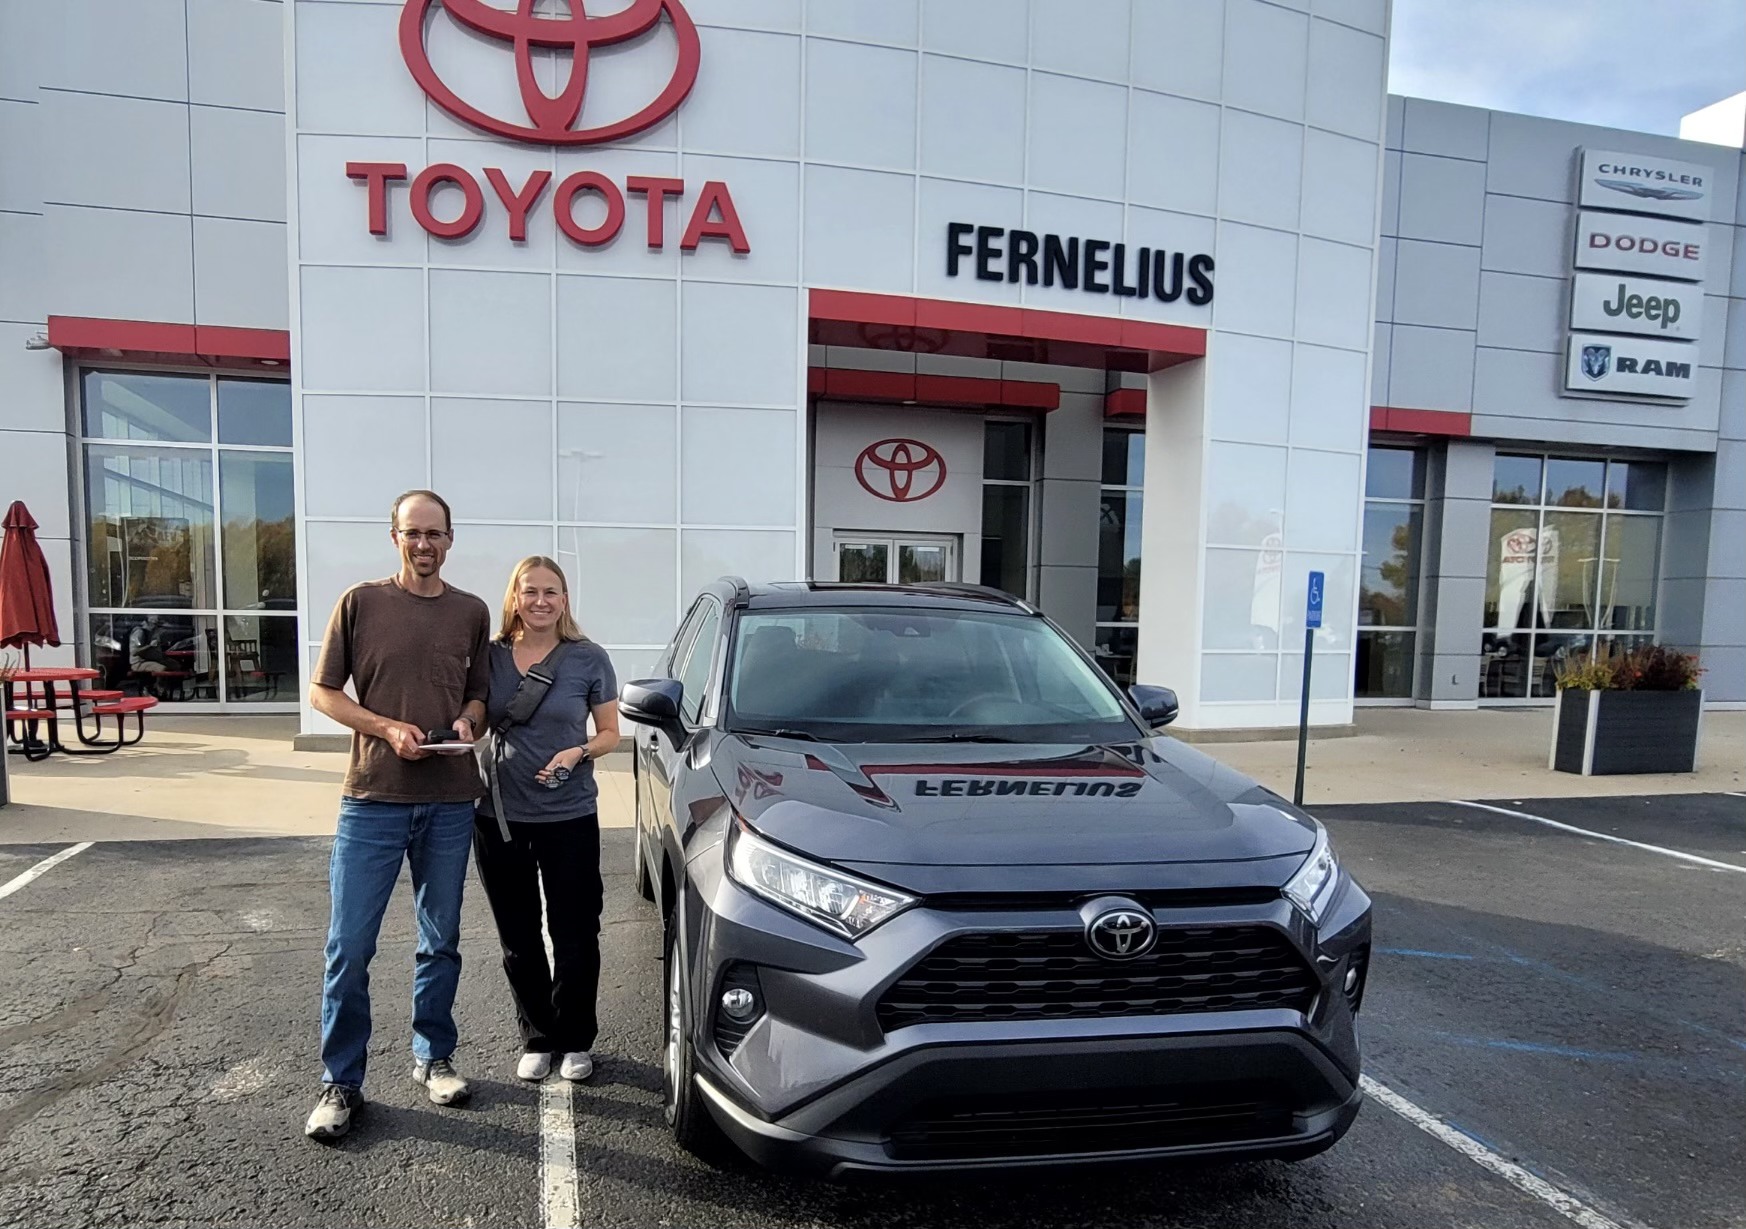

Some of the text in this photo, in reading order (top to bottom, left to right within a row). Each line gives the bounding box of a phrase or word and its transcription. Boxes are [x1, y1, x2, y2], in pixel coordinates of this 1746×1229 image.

[1598, 163, 1703, 188] CHRYSLER
[346, 161, 751, 254] TOYOTA
[946, 222, 1215, 305] FERNELIUS
[1589, 232, 1700, 261] DODGE
[1602, 283, 1681, 329] Jeep
[1616, 356, 1691, 379] RAM
